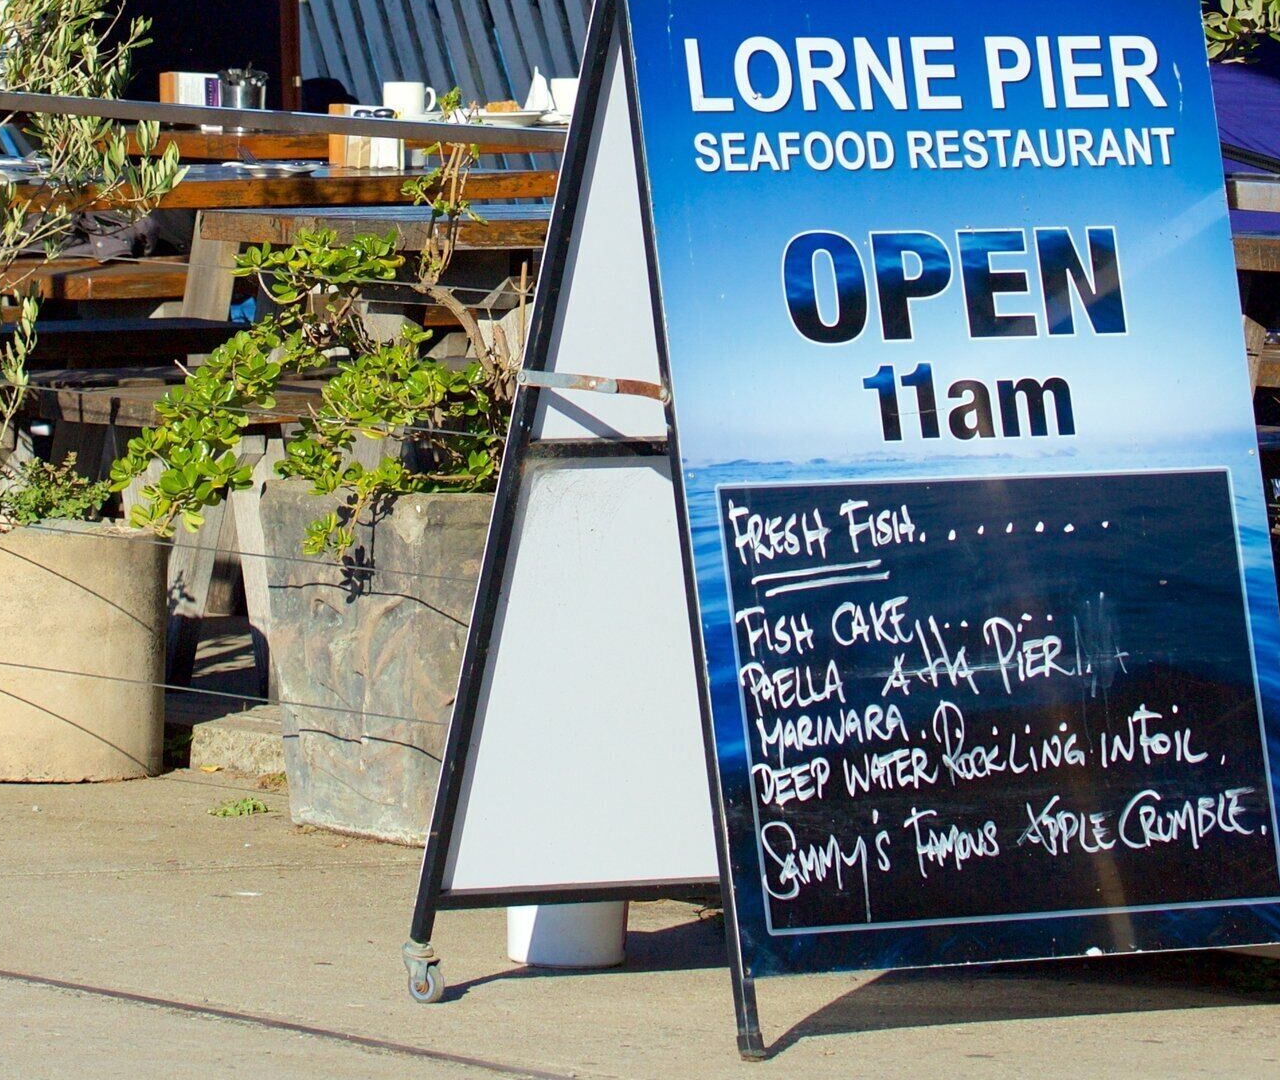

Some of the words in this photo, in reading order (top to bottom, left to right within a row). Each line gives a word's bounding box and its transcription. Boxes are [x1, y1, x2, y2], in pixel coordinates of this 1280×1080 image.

[684, 36, 963, 113] LORNE
[985, 34, 1168, 110] PIER
[694, 130, 895, 172] SEAFOOD
[907, 126, 1175, 169] RESTAURANT
[781, 225, 1128, 346] OPEN
[863, 361, 1076, 442] 11am
[735, 606, 814, 657] FISH
[831, 595, 913, 646] CAKE
[751, 756, 830, 806] DEEP
[842, 748, 938, 798] WATER
